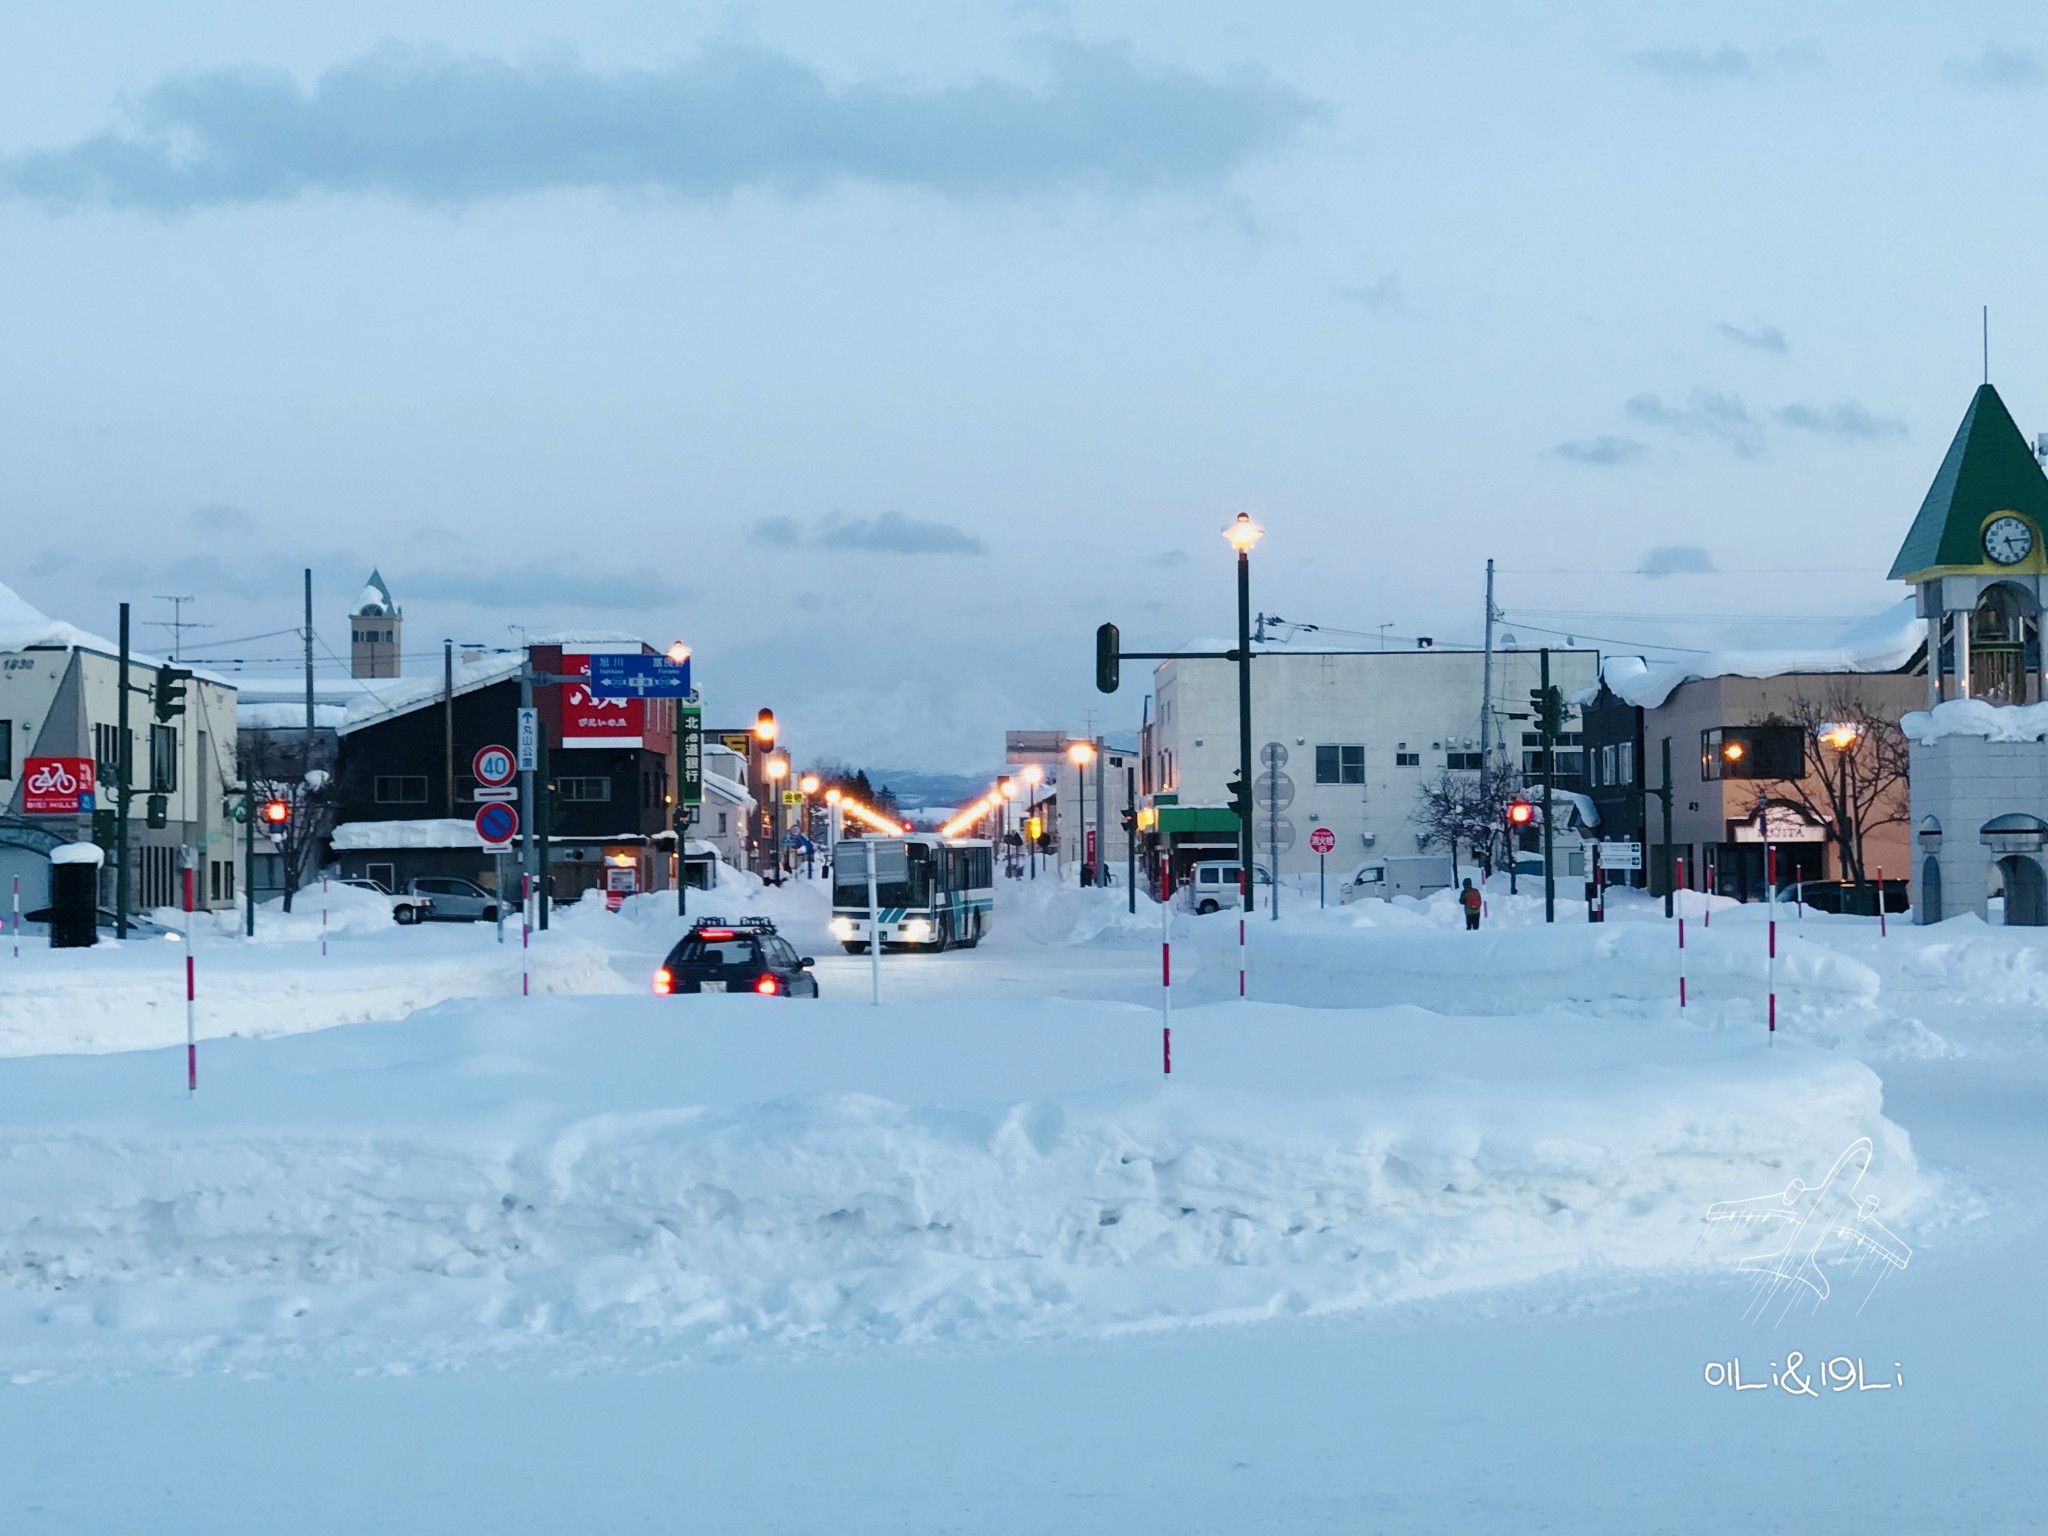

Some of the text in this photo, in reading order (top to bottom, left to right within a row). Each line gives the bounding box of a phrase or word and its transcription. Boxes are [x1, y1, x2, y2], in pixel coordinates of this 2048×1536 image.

[599, 657, 624, 667] 旭川
[522, 725, 533, 768] 丸山公園
[483, 757, 507, 775] 40
[1311, 835, 1334, 846] 消火栓
